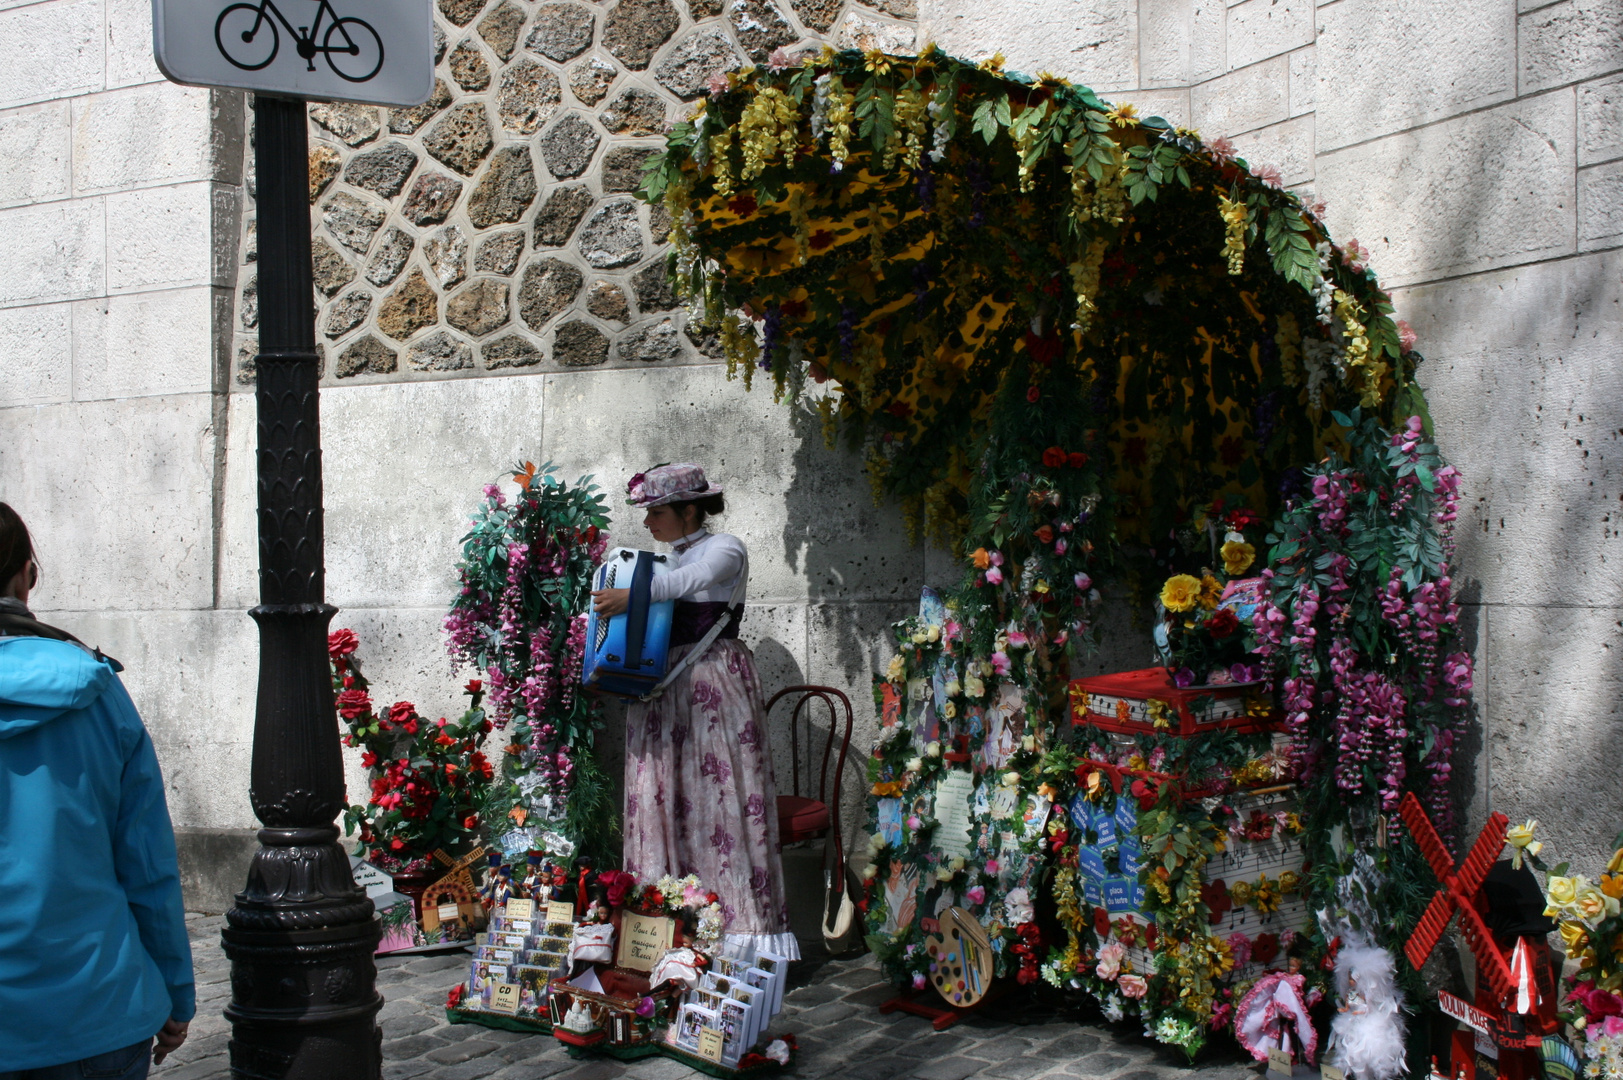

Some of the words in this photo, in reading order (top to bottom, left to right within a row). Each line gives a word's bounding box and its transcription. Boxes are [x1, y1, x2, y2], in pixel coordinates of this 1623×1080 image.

[1127, 854, 1136, 862] rue
[1109, 886, 1123, 896] place
[1136, 887, 1145, 896] pla
[1107, 897, 1114, 905] du
[1115, 896, 1128, 905] tertre
[632, 921, 649, 935] Pour
[650, 925, 657, 937] la
[631, 939, 657, 950] musique
[631, 945, 652, 960] Merci
[499, 985, 512, 995] CD
[1439, 991, 1465, 1020] MOULIN
[1468, 1007, 1489, 1030] ROUGE
[1499, 1035, 1526, 1050] ROUGE
